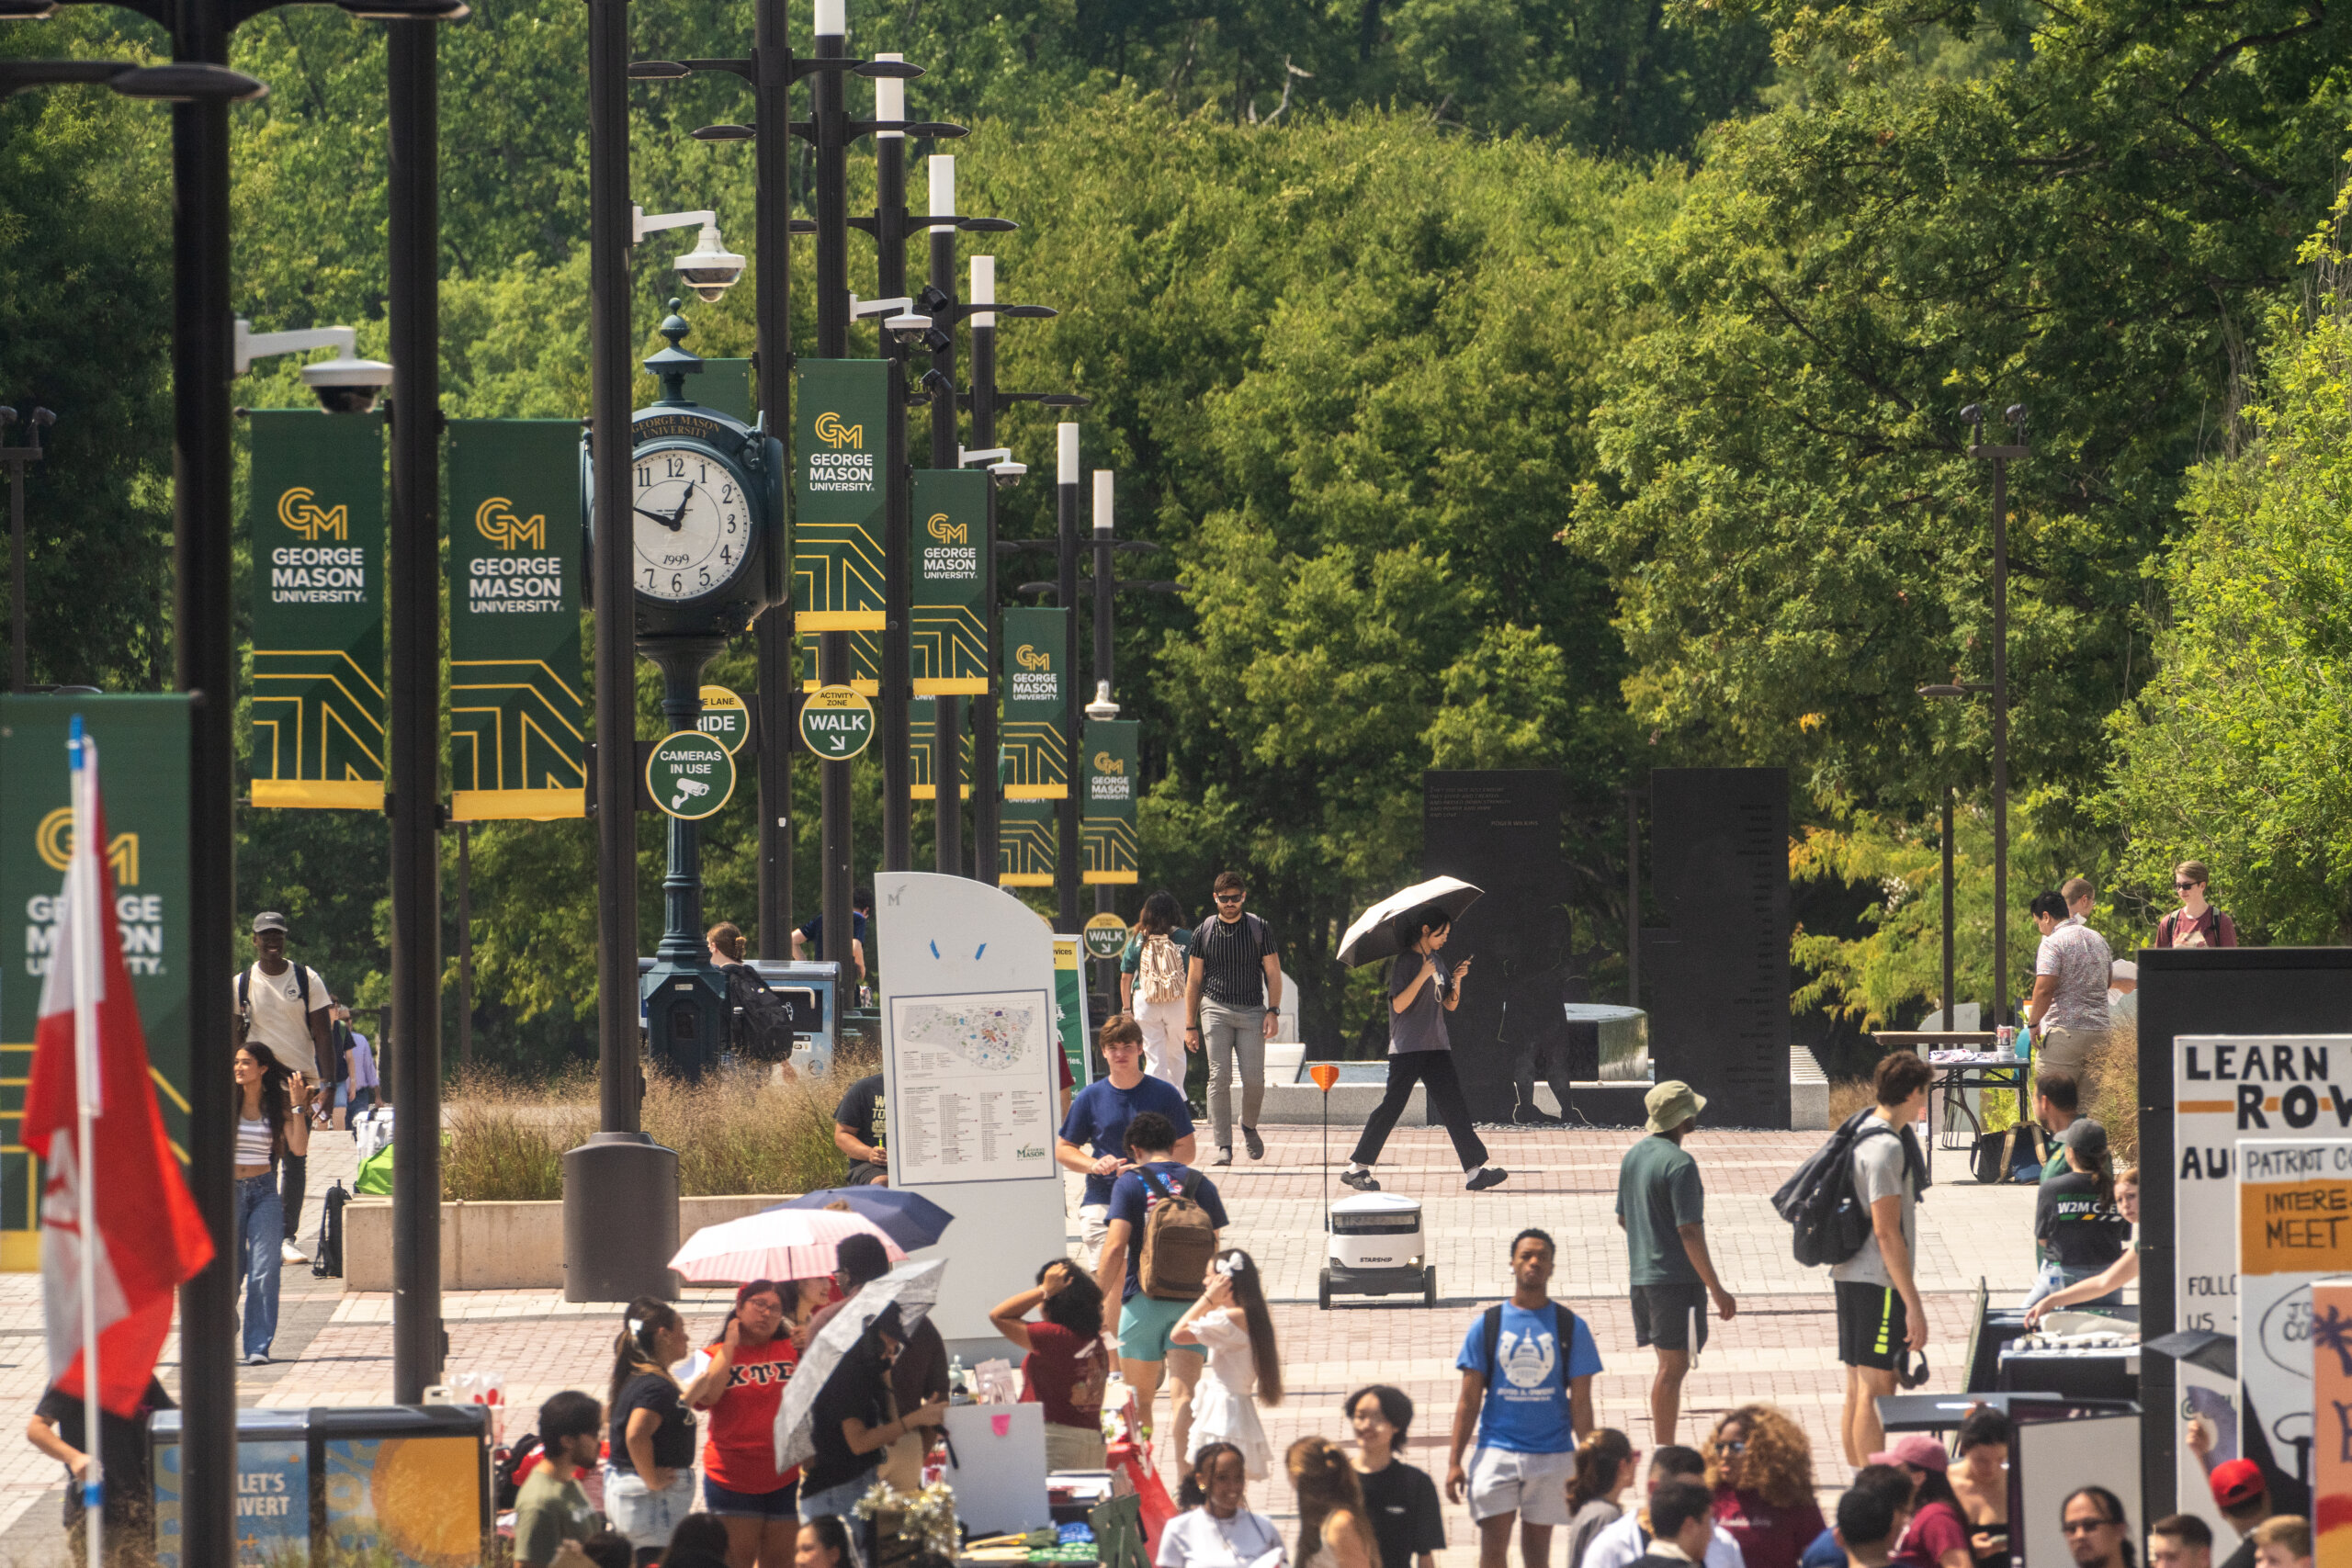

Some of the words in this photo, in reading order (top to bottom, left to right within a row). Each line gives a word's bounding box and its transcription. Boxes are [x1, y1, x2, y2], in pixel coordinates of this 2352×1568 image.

[632, 415, 675, 433] GEORGE
[681, 415, 721, 432] MASON
[643, 425, 707, 439] UNIVERSITY
[667, 457, 685, 478] 12
[810, 454, 873, 467] GEORGE
[638, 468, 651, 487] 11
[699, 464, 707, 483] 1
[809, 468, 873, 481] MASON
[722, 484, 733, 504] 2
[809, 483, 873, 491] UNIVERSITY
[727, 513, 737, 534] 3
[272, 547, 364, 566] GEORGE
[662, 553, 689, 566] 1999
[719, 544, 732, 565] 4
[923, 547, 977, 558] GEORGE
[469, 558, 561, 576] GEORGE
[923, 559, 977, 570] MASON
[272, 568, 364, 588] MASON
[642, 568, 658, 589] 7
[672, 572, 682, 593] 6
[698, 565, 711, 586] 5
[923, 571, 976, 580] UNIVERSITY
[272, 591, 365, 603] UNIVERSITY
[469, 578, 561, 598] MASON
[469, 600, 561, 614] UNIVERSITY
[1012, 673, 1057, 682] GEORGE
[1012, 683, 1057, 694] MASON
[808, 715, 866, 731] WALK
[660, 750, 722, 761] CAMERAS
[670, 764, 683, 774] IN
[686, 763, 712, 774] USE
[1091, 776, 1129, 784] GEORGE
[1091, 784, 1129, 794] MASON
[1089, 931, 1124, 942] WALK
[2186, 1044, 2328, 1081] LEARN
[1017, 1148, 1046, 1158] MASON
[2180, 1146, 2235, 1180] AU
[2246, 1147, 2326, 1179] PATRIOT
[2058, 1201, 2090, 1214] W2M
[2265, 1189, 2352, 1214] INTERE
[2265, 1215, 2350, 1249] MEET
[2187, 1313, 2215, 1332] US
[237, 1472, 286, 1494] LET'S
[236, 1496, 290, 1517] IVERT
